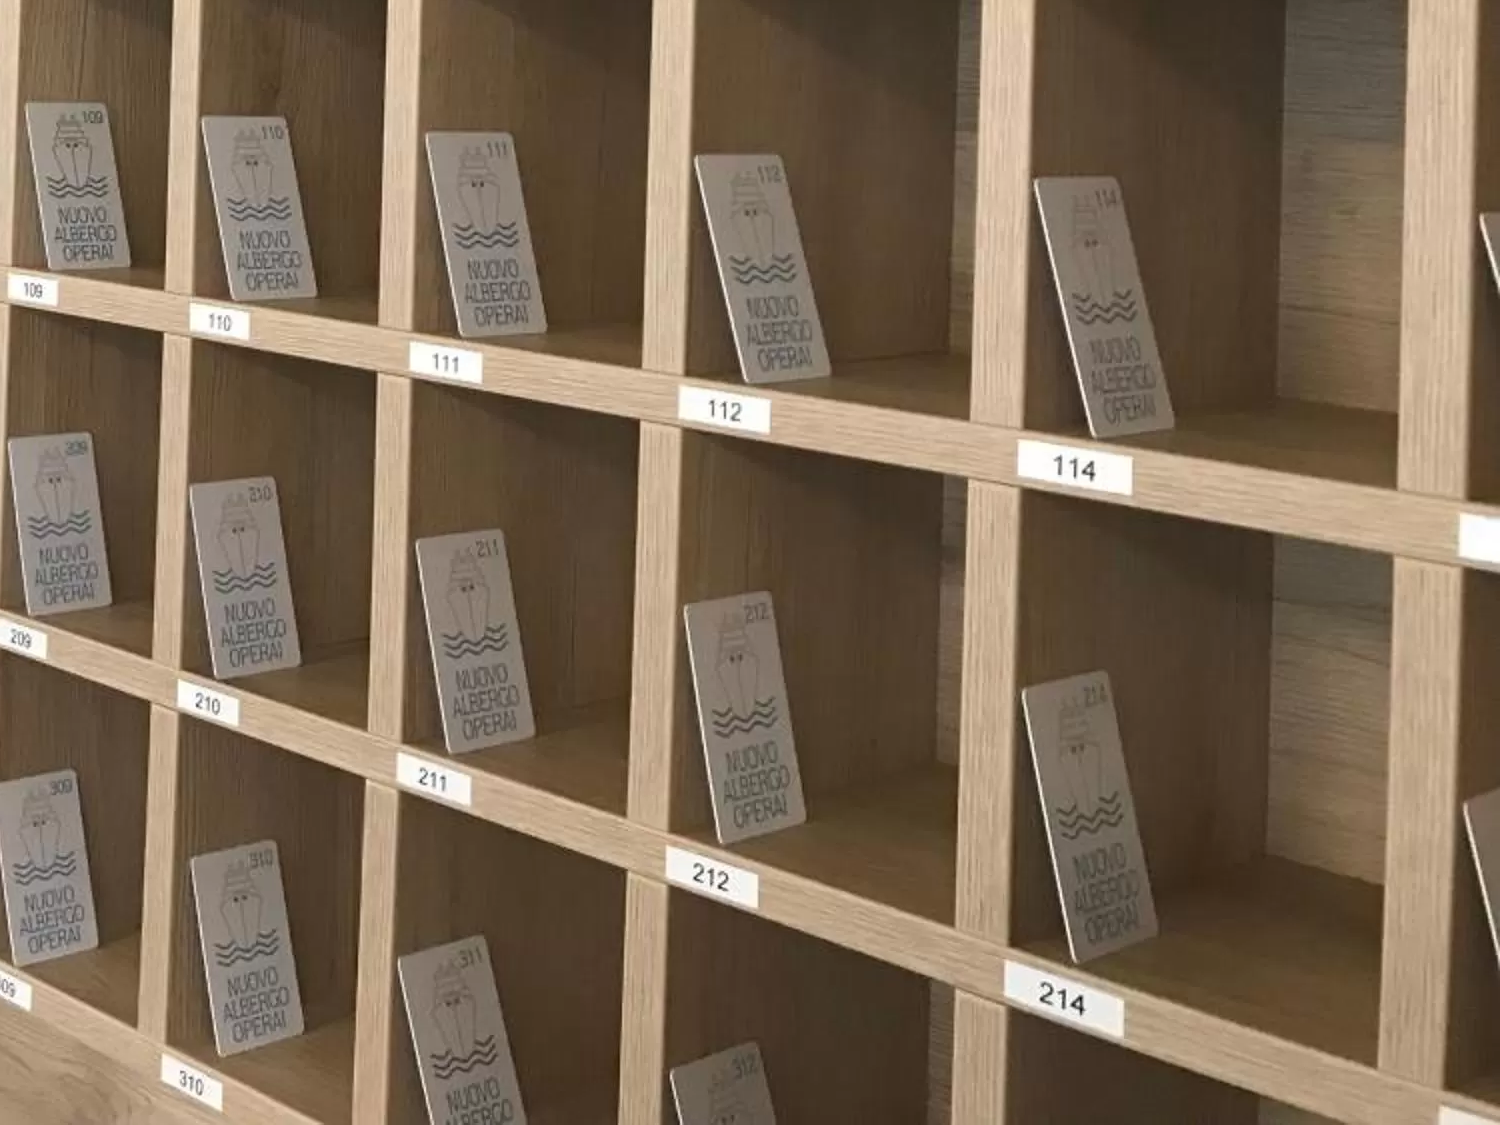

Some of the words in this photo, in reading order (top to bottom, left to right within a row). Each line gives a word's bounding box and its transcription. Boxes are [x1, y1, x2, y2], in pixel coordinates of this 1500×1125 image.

[82, 111, 104, 124] 109
[58, 206, 107, 224] NUOVO
[55, 225, 116, 243] ALBERGO
[240, 230, 291, 249] NUOVO
[62, 244, 114, 261] OPERAI
[237, 251, 300, 271] ALBERGO
[245, 273, 299, 291] OPERAI
[467, 259, 519, 280] NUOVO
[24, 282, 43, 297] 109
[464, 280, 531, 304] ALBERGO
[474, 304, 529, 328] OPERAI
[747, 296, 799, 321] NUOVO
[208, 313, 231, 331] 110
[747, 320, 813, 346] ALBERGO
[757, 347, 812, 372] OPERAI
[1091, 336, 1142, 364] NUOVO
[433, 353, 460, 373] 111
[1092, 363, 1156, 394] ALBERGO
[708, 400, 742, 422] 112
[1103, 395, 1157, 426] OPERAI
[1053, 455, 1096, 482] 114
[248, 486, 271, 502] 210
[39, 543, 88, 564] NUOVO
[475, 539, 499, 558] 211
[35, 563, 98, 586] ALBERGO
[43, 585, 94, 605] OPERAI
[224, 598, 276, 623] NUOVO
[11, 629, 32, 649] 209
[221, 618, 287, 646] ALBERGO
[229, 644, 283, 668] OPERAI
[455, 662, 508, 692] NUOVO
[195, 692, 221, 715] 210
[452, 684, 520, 717] ALBERGO
[462, 712, 517, 741] OPERAI
[725, 740, 778, 771] NUOVO
[50, 779, 73, 795] 309
[419, 768, 447, 791] 211
[723, 766, 790, 804] ALBERGO
[733, 797, 788, 829] OPERAI
[1072, 842, 1127, 872] NUOVO
[692, 862, 729, 892] 212
[24, 885, 75, 912] NUOVO
[1073, 870, 1139, 913] ALBERGO
[20, 905, 84, 936] ALBERGO
[1084, 904, 1139, 945] OPERAI
[28, 927, 81, 954] OPERAI
[459, 946, 484, 969] 311
[227, 967, 279, 996] NUOVO
[223, 986, 290, 1023] ALBERGO
[1039, 982, 1086, 1016] 214
[232, 1013, 287, 1043] OPERAI
[730, 1054, 757, 1080] 312
[179, 1070, 204, 1096] 310
[446, 1077, 500, 1116] NUOVO
